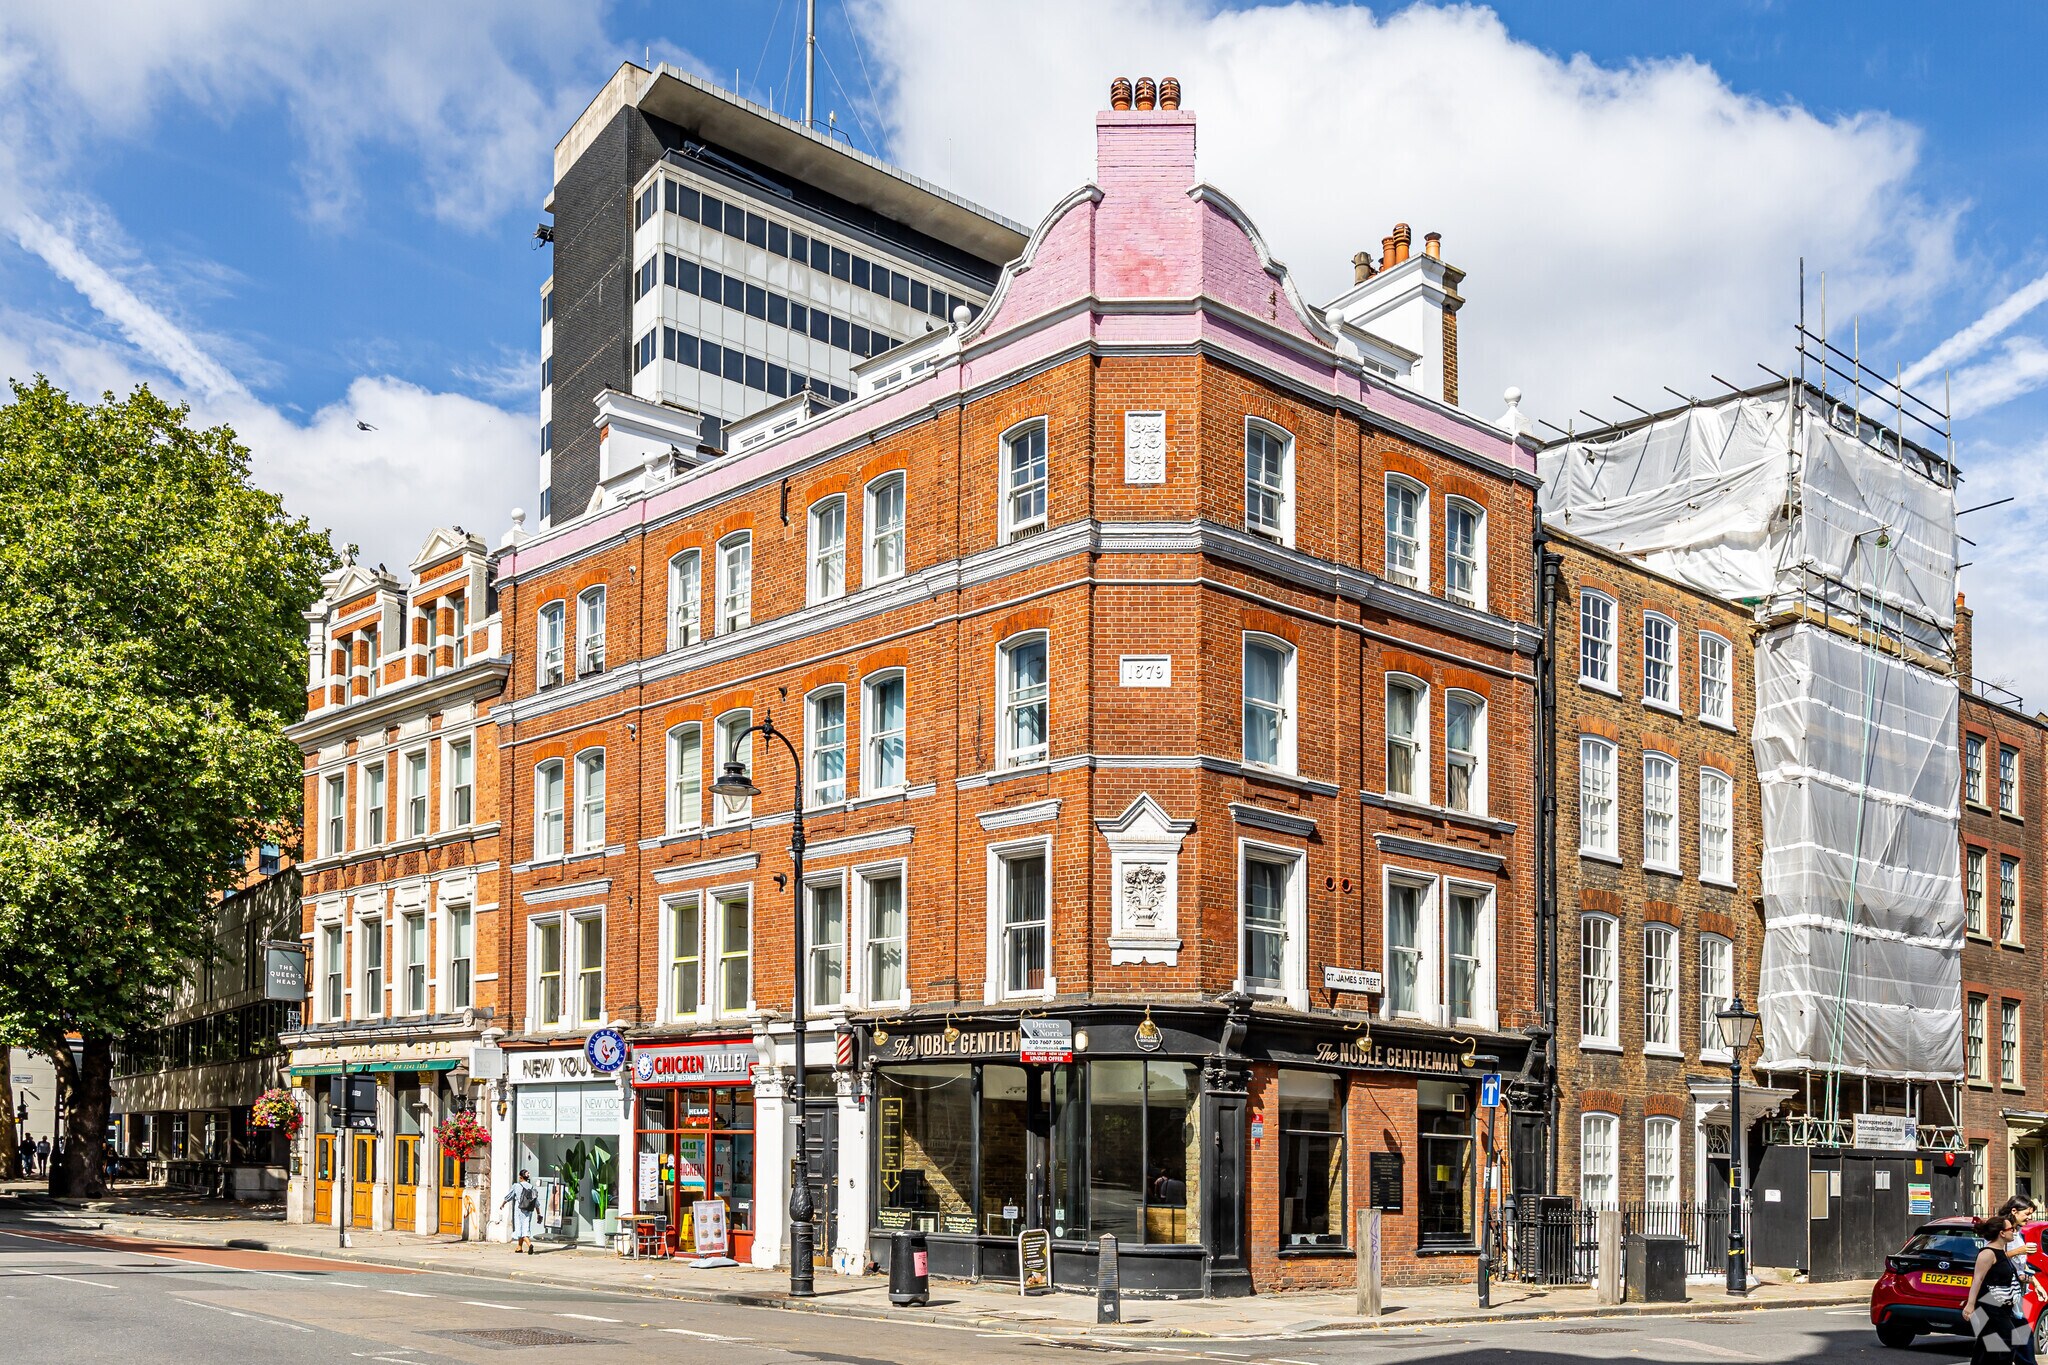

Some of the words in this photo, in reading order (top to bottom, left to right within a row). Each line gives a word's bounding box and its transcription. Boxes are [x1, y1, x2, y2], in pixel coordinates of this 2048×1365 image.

[269, 970, 302, 979] QUEEN'S
[1326, 973, 1336, 982] GT.
[1336, 974, 1357, 984] JAMES
[1358, 976, 1380, 986] STREET
[276, 978, 297, 986] HEAD
[1032, 1020, 1060, 1029] Drivers
[415, 1040, 452, 1057] HEAD
[893, 1038, 914, 1058] The
[916, 1034, 955, 1055] NOBLE
[960, 1031, 1021, 1054] GENTLEM
[1314, 1042, 1338, 1061] The
[1340, 1042, 1382, 1065] NOBLE
[1386, 1047, 1458, 1072] GENTLEMAN
[523, 1058, 554, 1078] NEW
[559, 1056, 588, 1077] YOU
[654, 1055, 704, 1075] CHICKEN
[706, 1053, 749, 1073] VALLEY
[521, 1098, 537, 1109] NEW
[538, 1098, 552, 1109] YOU
[585, 1098, 602, 1109] NEW
[603, 1098, 619, 1109] YOU
[1950, 1276, 1968, 1285] FSG
